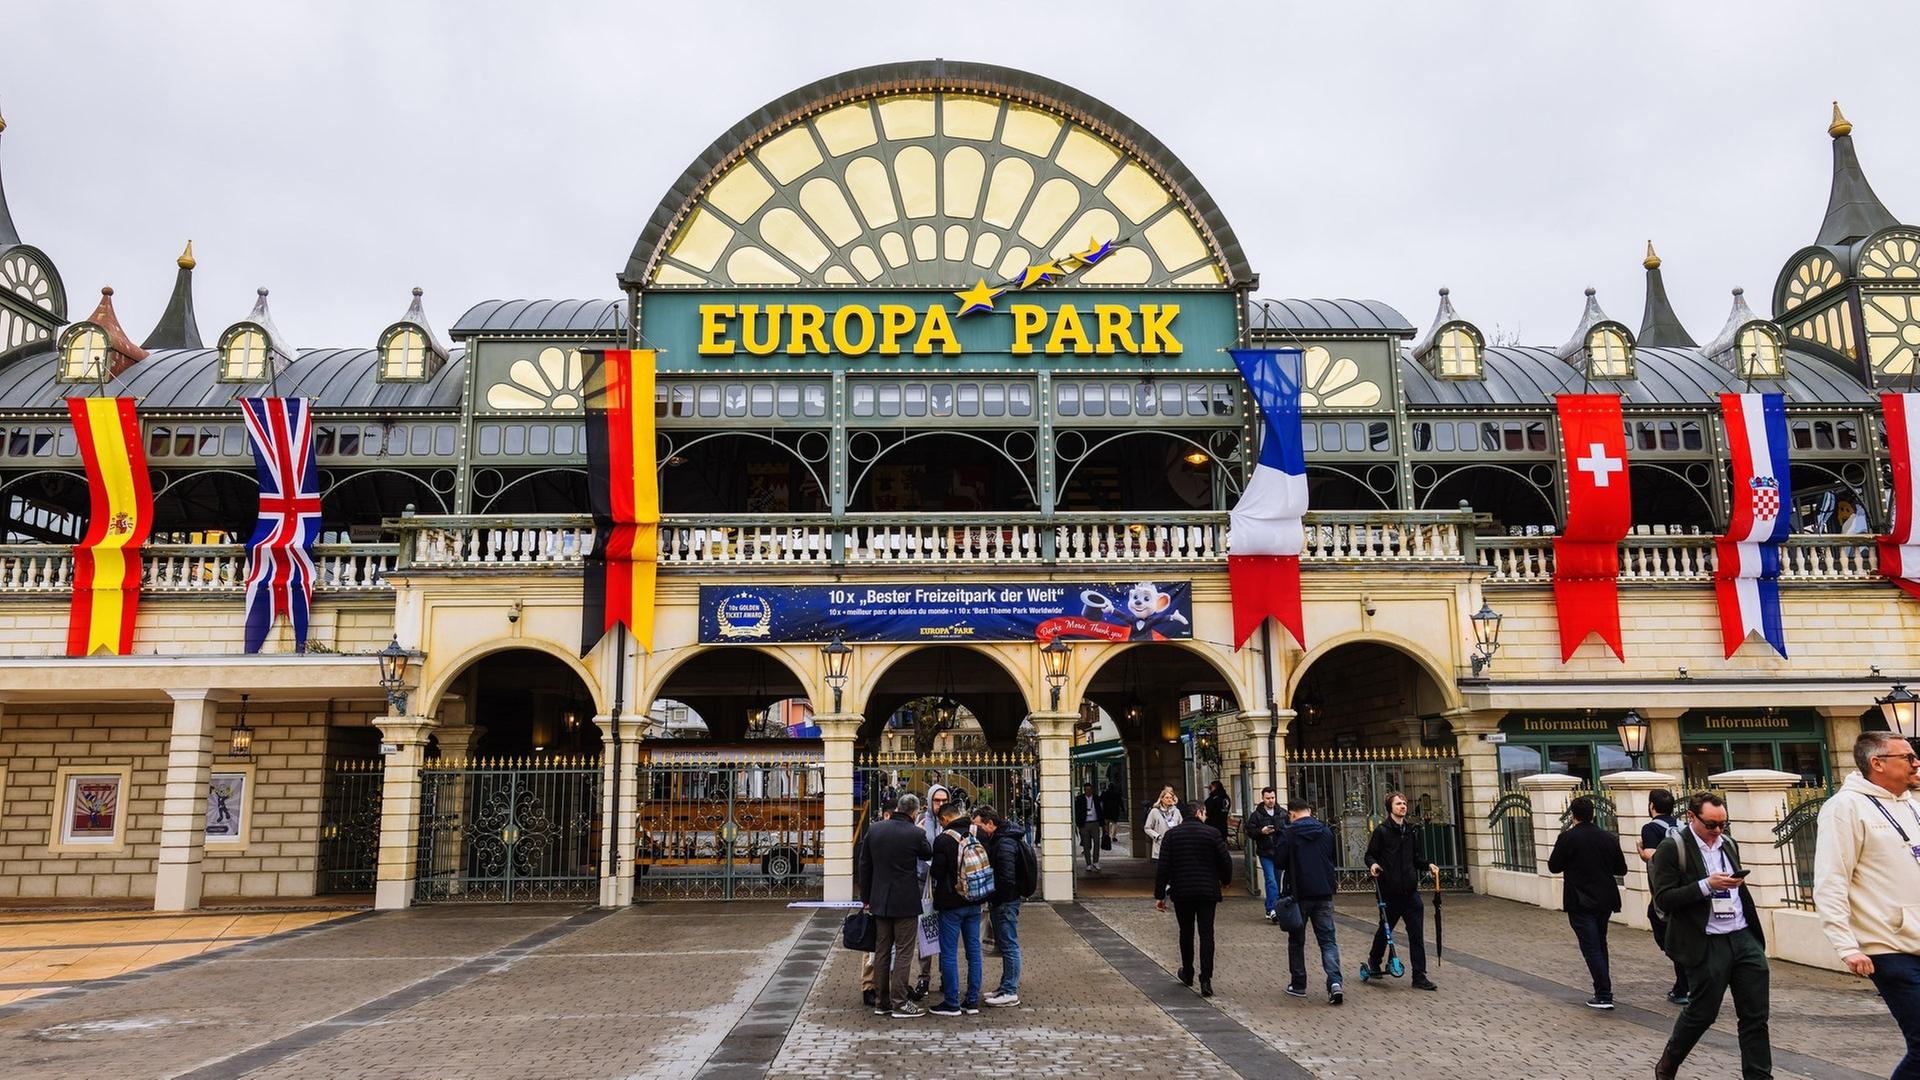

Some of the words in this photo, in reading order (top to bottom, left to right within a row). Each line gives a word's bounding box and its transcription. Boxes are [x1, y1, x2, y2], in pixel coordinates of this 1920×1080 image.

[697, 303, 963, 356] EUROPA
[1010, 303, 1185, 356] PARK
[828, 590, 845, 604] 10
[846, 593, 855, 604] x
[859, 590, 912, 606] „Bester
[915, 589, 997, 606] Freizeitpark
[1000, 588, 1023, 602] der
[1026, 588, 1064, 602] Welt“
[919, 627, 950, 635] EUROPA
[953, 627, 975, 635] PARK
[1064, 619, 1086, 630] Merci
[1089, 623, 1110, 636] Thank
[1109, 631, 1123, 640] you
[1523, 717, 1608, 731] Information
[1705, 715, 1790, 728] Information
